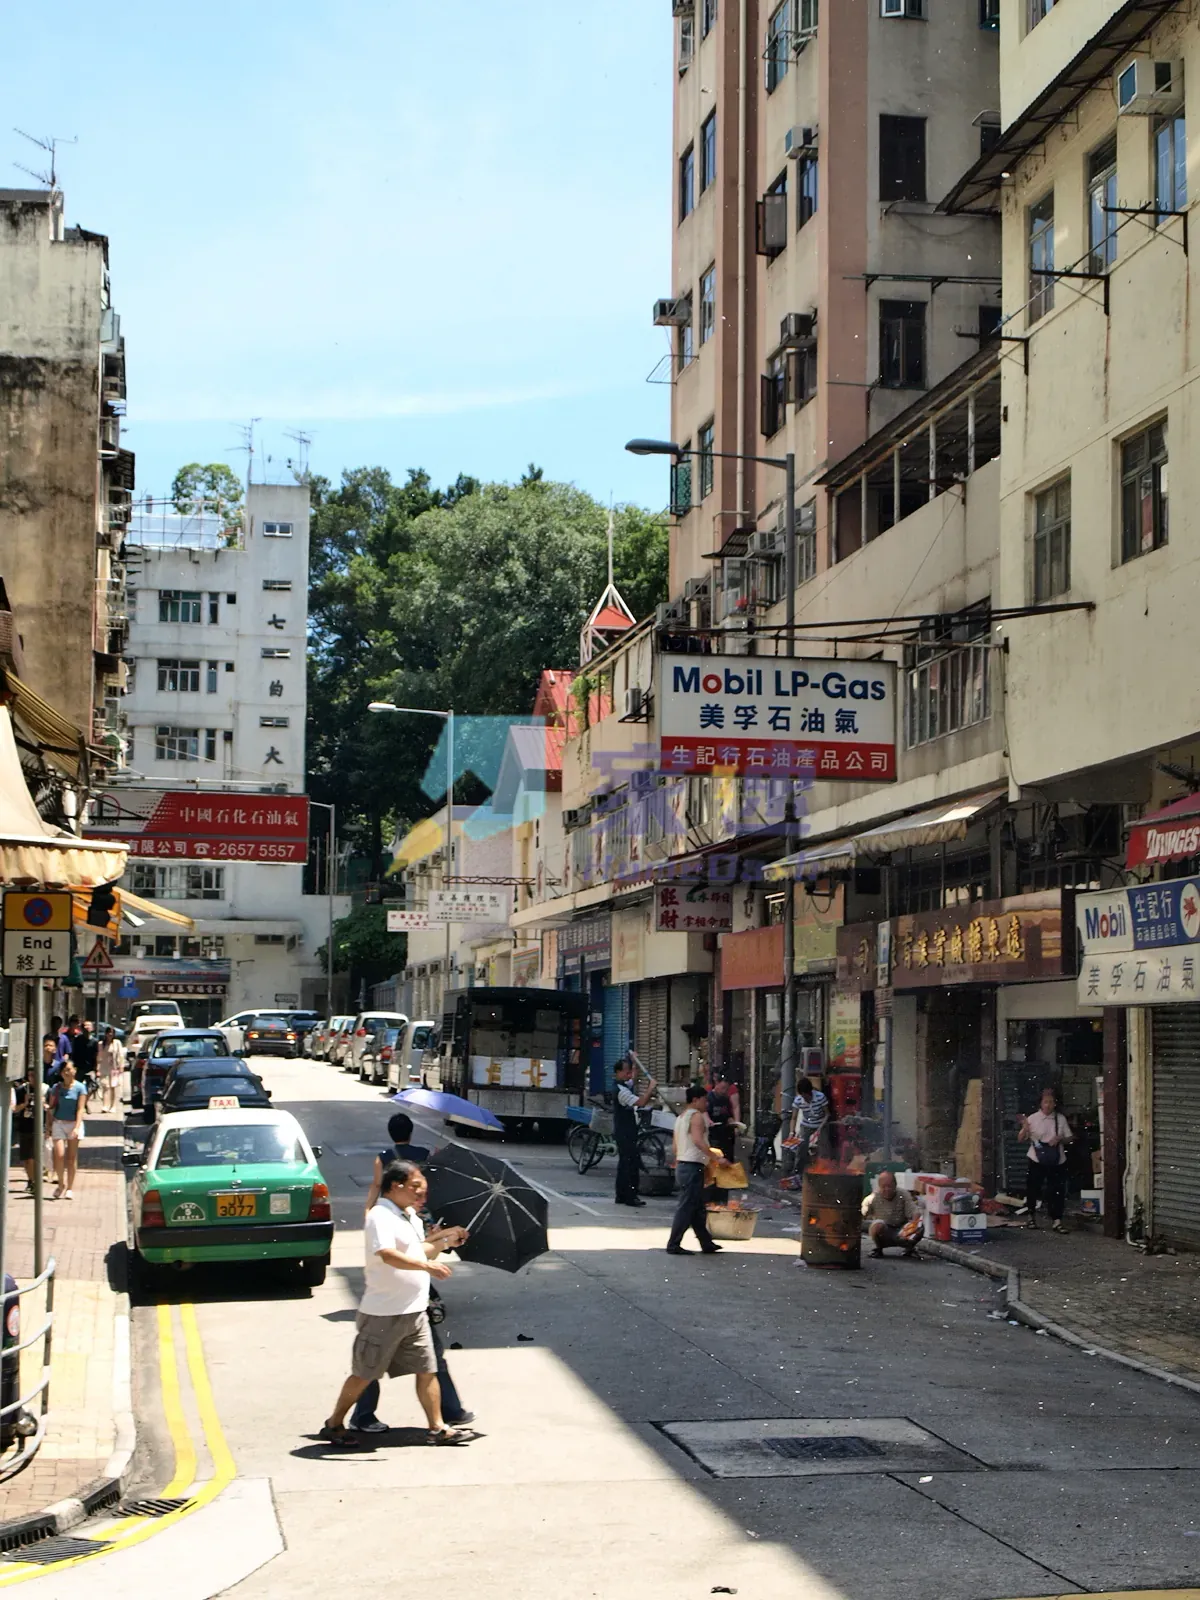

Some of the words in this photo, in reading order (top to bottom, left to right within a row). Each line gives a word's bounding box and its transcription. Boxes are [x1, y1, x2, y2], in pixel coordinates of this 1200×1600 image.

[673, 666, 762, 696] Mobil
[775, 670, 886, 700] LP-Gas
[700, 704, 859, 734] 美孚石油氣
[671, 744, 888, 773] 生記行石油產品公司
[179, 807, 299, 826] 中國石化石油氣
[259, 845, 295, 857] 5557
[1135, 890, 1172, 923] 生記行
[1085, 903, 1126, 940] Mobil
[23, 936, 52, 950] End
[16, 954, 57, 972] 終止
[124, 977, 133, 988] P
[1087, 956, 1195, 996] 美孚石油氣
[212, 1099, 236, 1107] TAXI
[228, 1195, 244, 1206] JV
[220, 1205, 254, 1216] 3077
